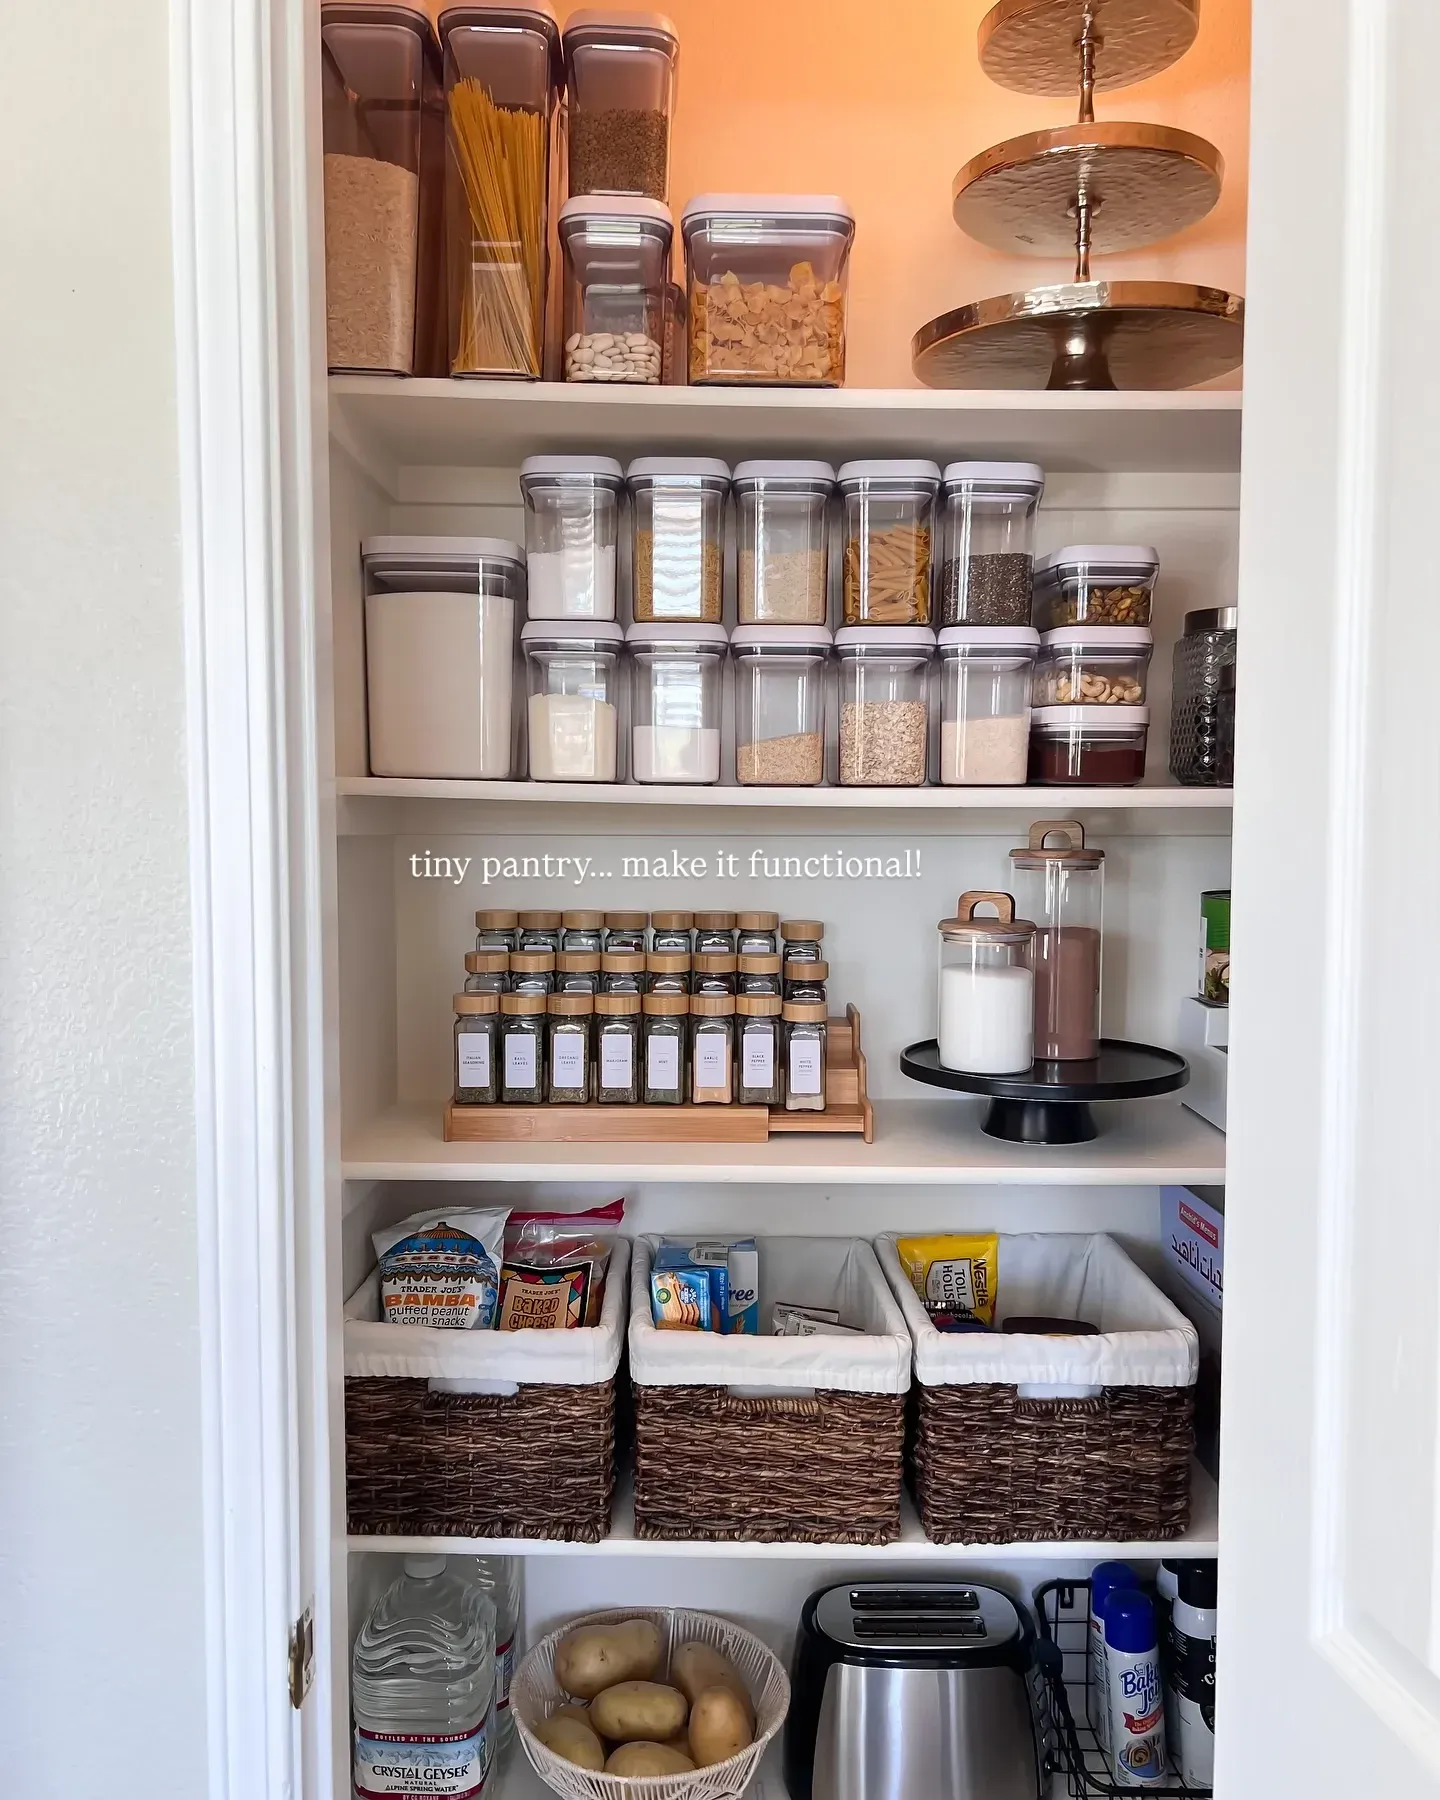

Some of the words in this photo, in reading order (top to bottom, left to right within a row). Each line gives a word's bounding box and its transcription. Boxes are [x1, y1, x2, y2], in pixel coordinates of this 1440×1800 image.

[400, 1285, 438, 1293] TRADER
[441, 1285, 466, 1294] JOE'S
[942, 1264, 955, 1302] HOUS
[955, 1268, 967, 1299] TOLL
[728, 1283, 754, 1301] ree
[385, 1294, 475, 1307] BAMBA
[389, 1305, 428, 1318] puffed
[431, 1306, 470, 1318] peanut
[402, 1316, 429, 1325] corn
[432, 1316, 466, 1326] snacks
[374, 1734, 406, 1742] BOTTLED
[440, 1733, 468, 1742] SOURCE
[372, 1765, 422, 1780] CRYSTAL
[423, 1764, 469, 1779] GEYSER
[384, 1784, 409, 1792] ALPINE
